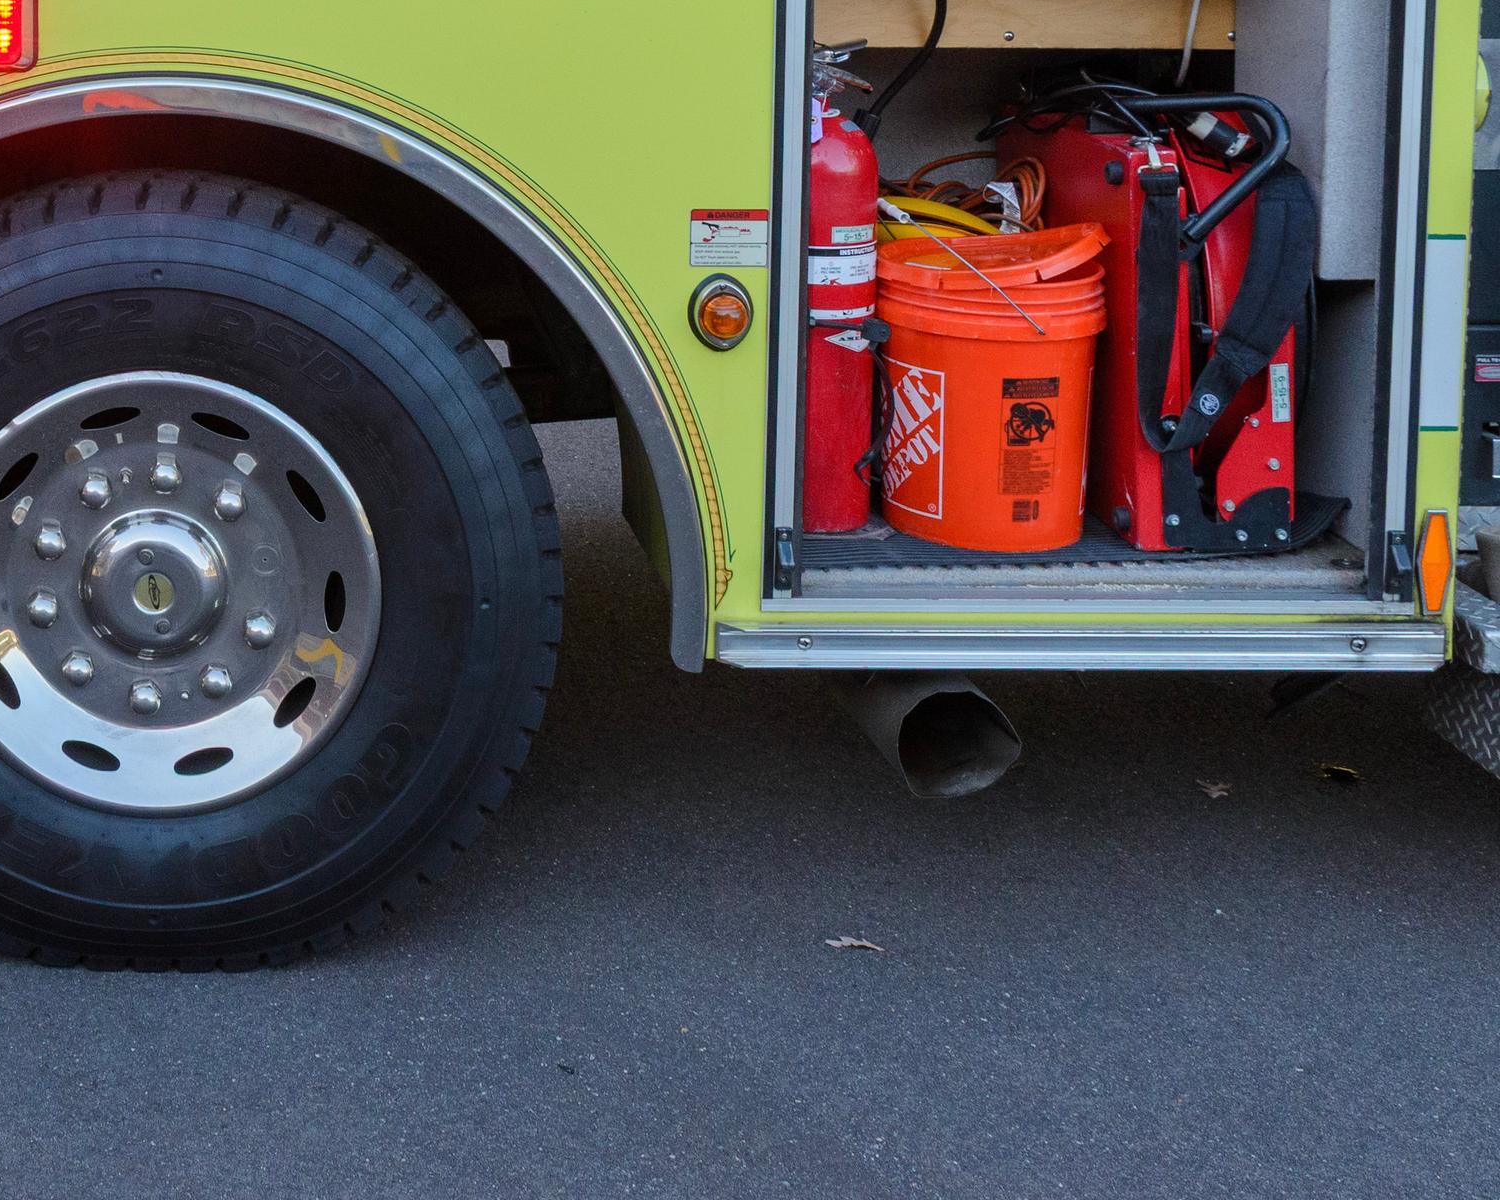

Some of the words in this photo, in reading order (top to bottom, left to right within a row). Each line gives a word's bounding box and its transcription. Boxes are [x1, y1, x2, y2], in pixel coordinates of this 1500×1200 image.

[715, 211, 751, 219] DANGER
[193, 302, 361, 395] RSD
[882, 424, 942, 499] DEPOT
